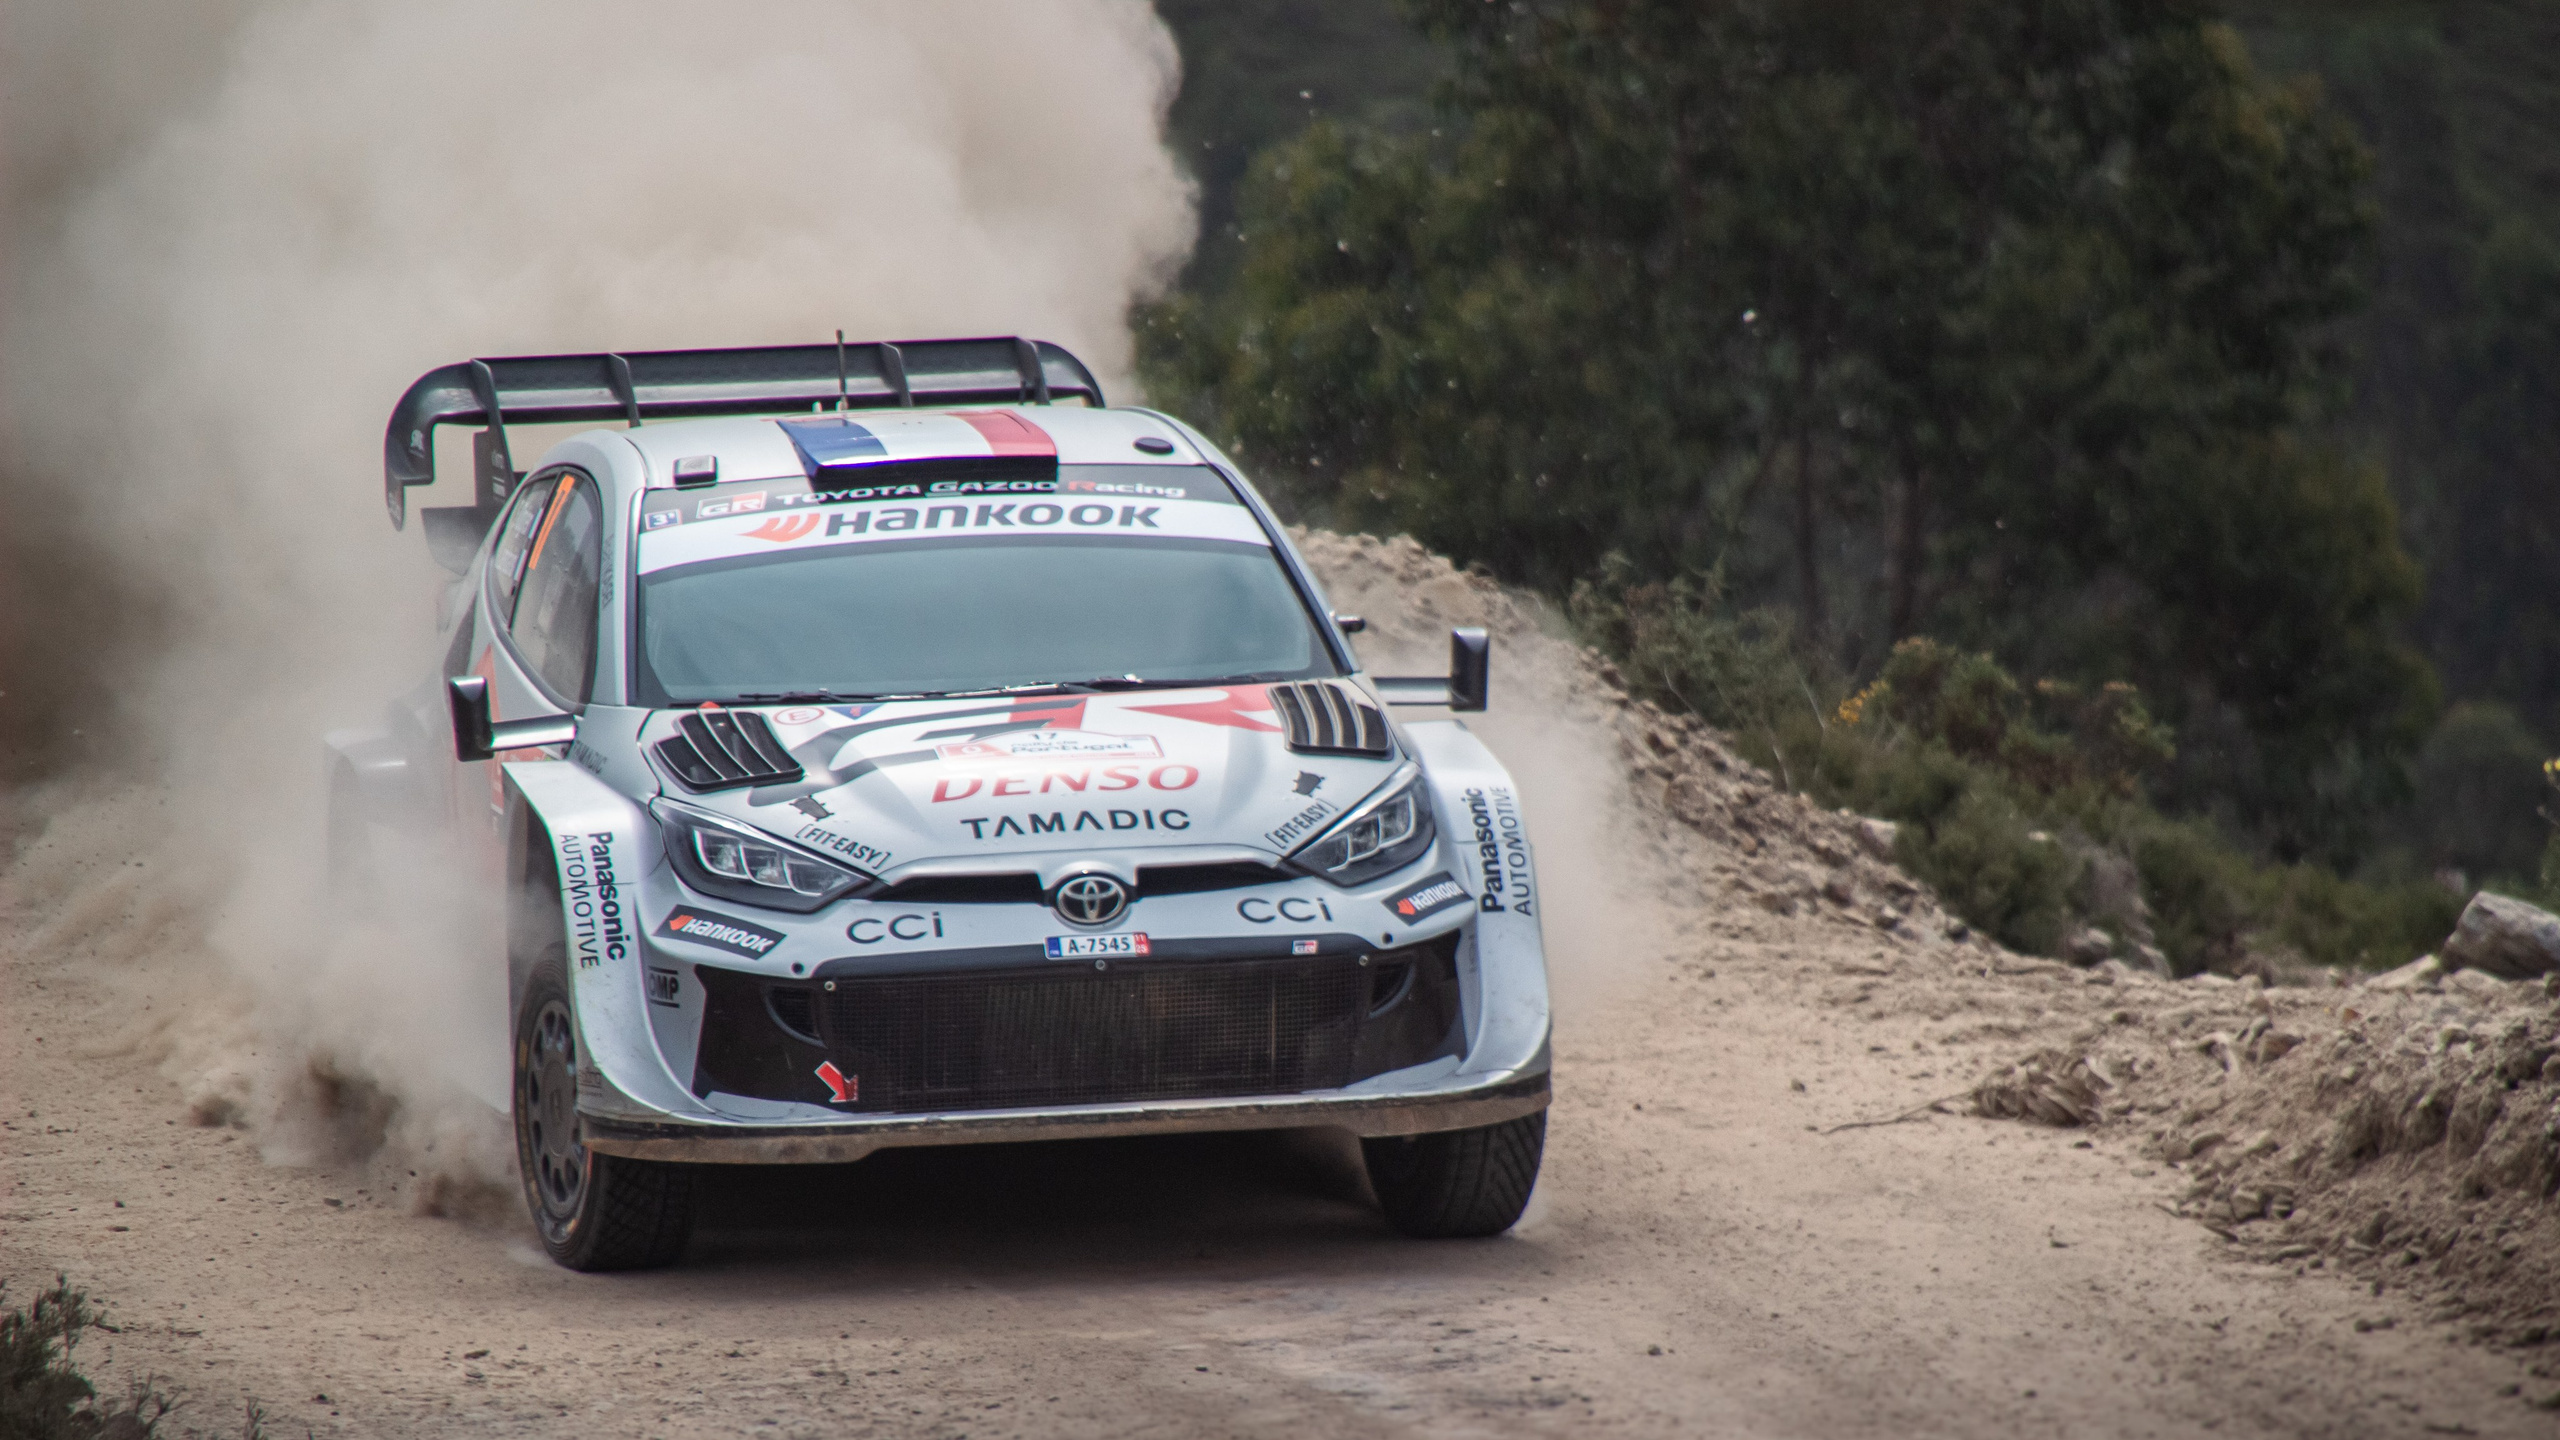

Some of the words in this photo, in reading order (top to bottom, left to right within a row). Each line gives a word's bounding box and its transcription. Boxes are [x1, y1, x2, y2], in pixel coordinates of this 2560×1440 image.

[700, 498, 761, 517] GR
[776, 484, 921, 505] TOYOTA
[930, 481, 1058, 493] GAZOO
[1069, 481, 1187, 498] Racing
[1011, 743, 1131, 754] Portugal
[932, 765, 1200, 803] DENSO
[960, 809, 1190, 839] TAMADIC
[1460, 788, 1505, 913] Panasonic
[1489, 785, 1532, 916] AUTOMOTIVE
[560, 834, 600, 969] AUTOMOTIVE
[588, 832, 630, 960] Panasonic
[1068, 937, 1131, 954] A-7545
